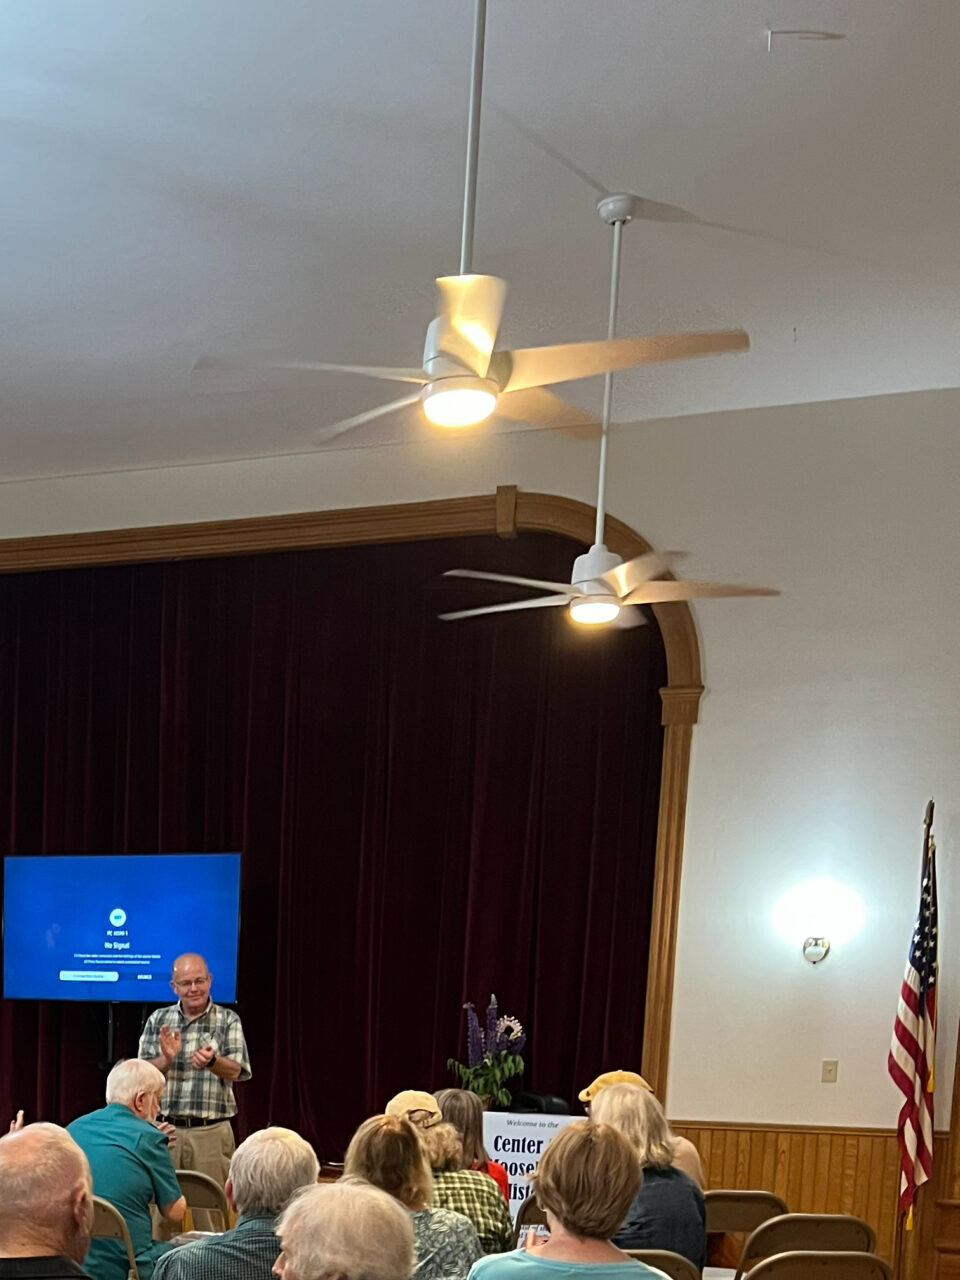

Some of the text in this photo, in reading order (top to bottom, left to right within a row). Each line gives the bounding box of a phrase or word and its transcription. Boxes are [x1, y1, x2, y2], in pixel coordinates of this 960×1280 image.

[113, 942, 130, 950] Signal
[506, 1119, 538, 1128] Welcome
[547, 1121, 559, 1129] the
[494, 1135, 543, 1153] Center
[489, 1158, 539, 1176] oose
